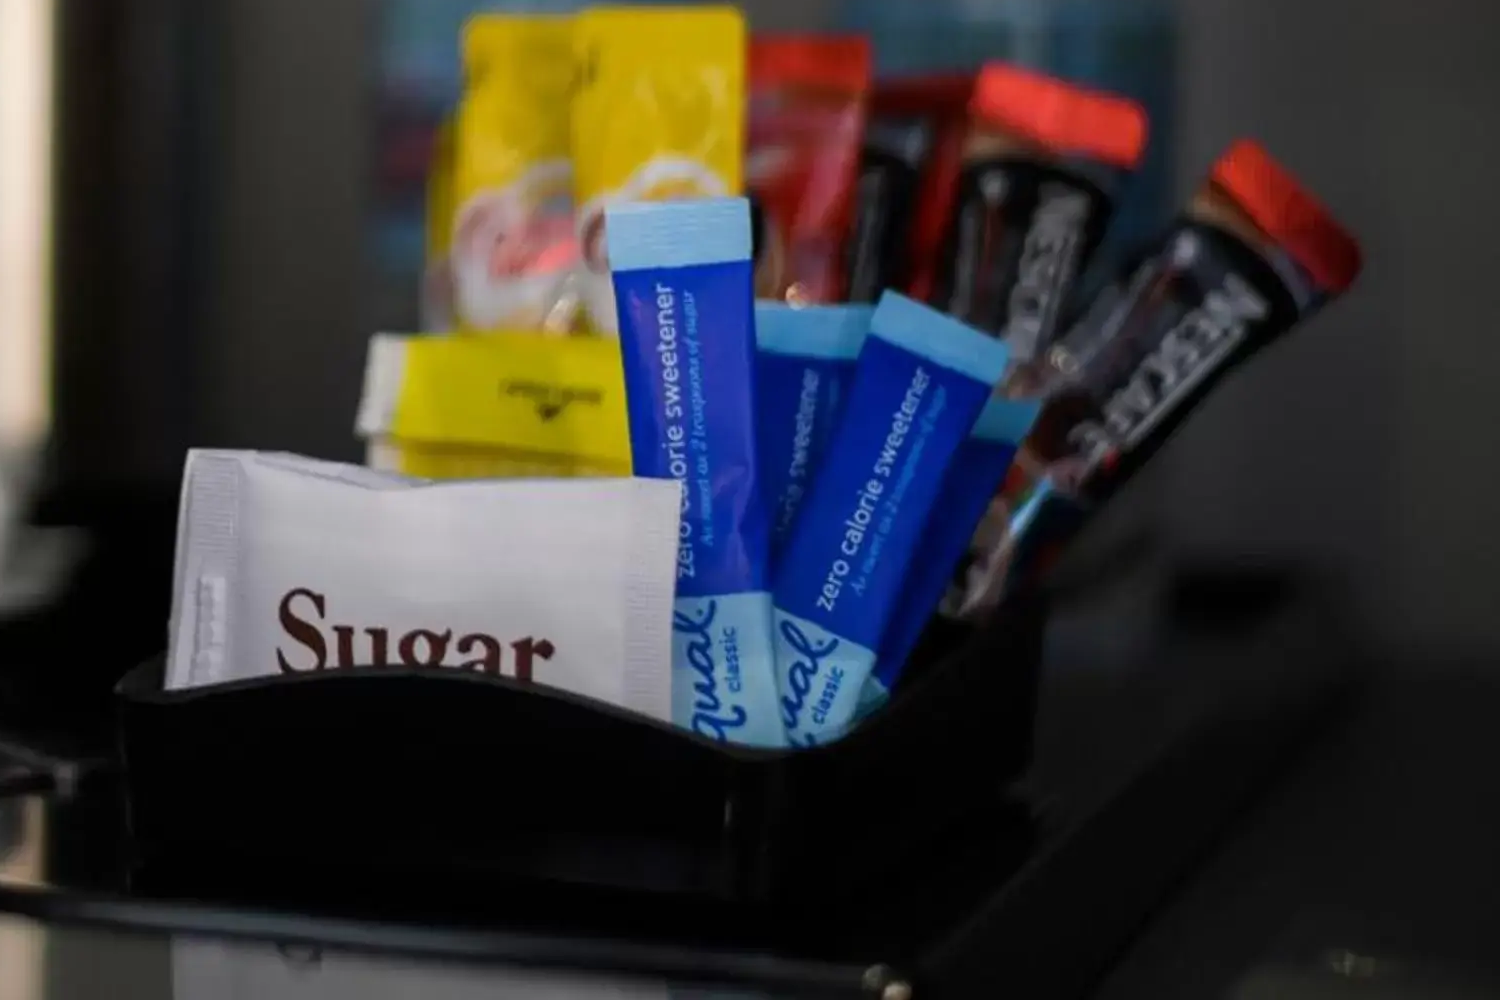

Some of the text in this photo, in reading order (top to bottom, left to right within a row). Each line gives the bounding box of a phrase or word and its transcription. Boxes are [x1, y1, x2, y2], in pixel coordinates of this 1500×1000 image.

[656, 283, 683, 418] sweetener
[816, 559, 850, 612] zero
[841, 478, 884, 556] calorie
[874, 366, 931, 478] sweetener
[275, 587, 556, 682] Sugar
[672, 599, 747, 743] qual
[719, 626, 742, 693] classic
[811, 665, 845, 725] classic
